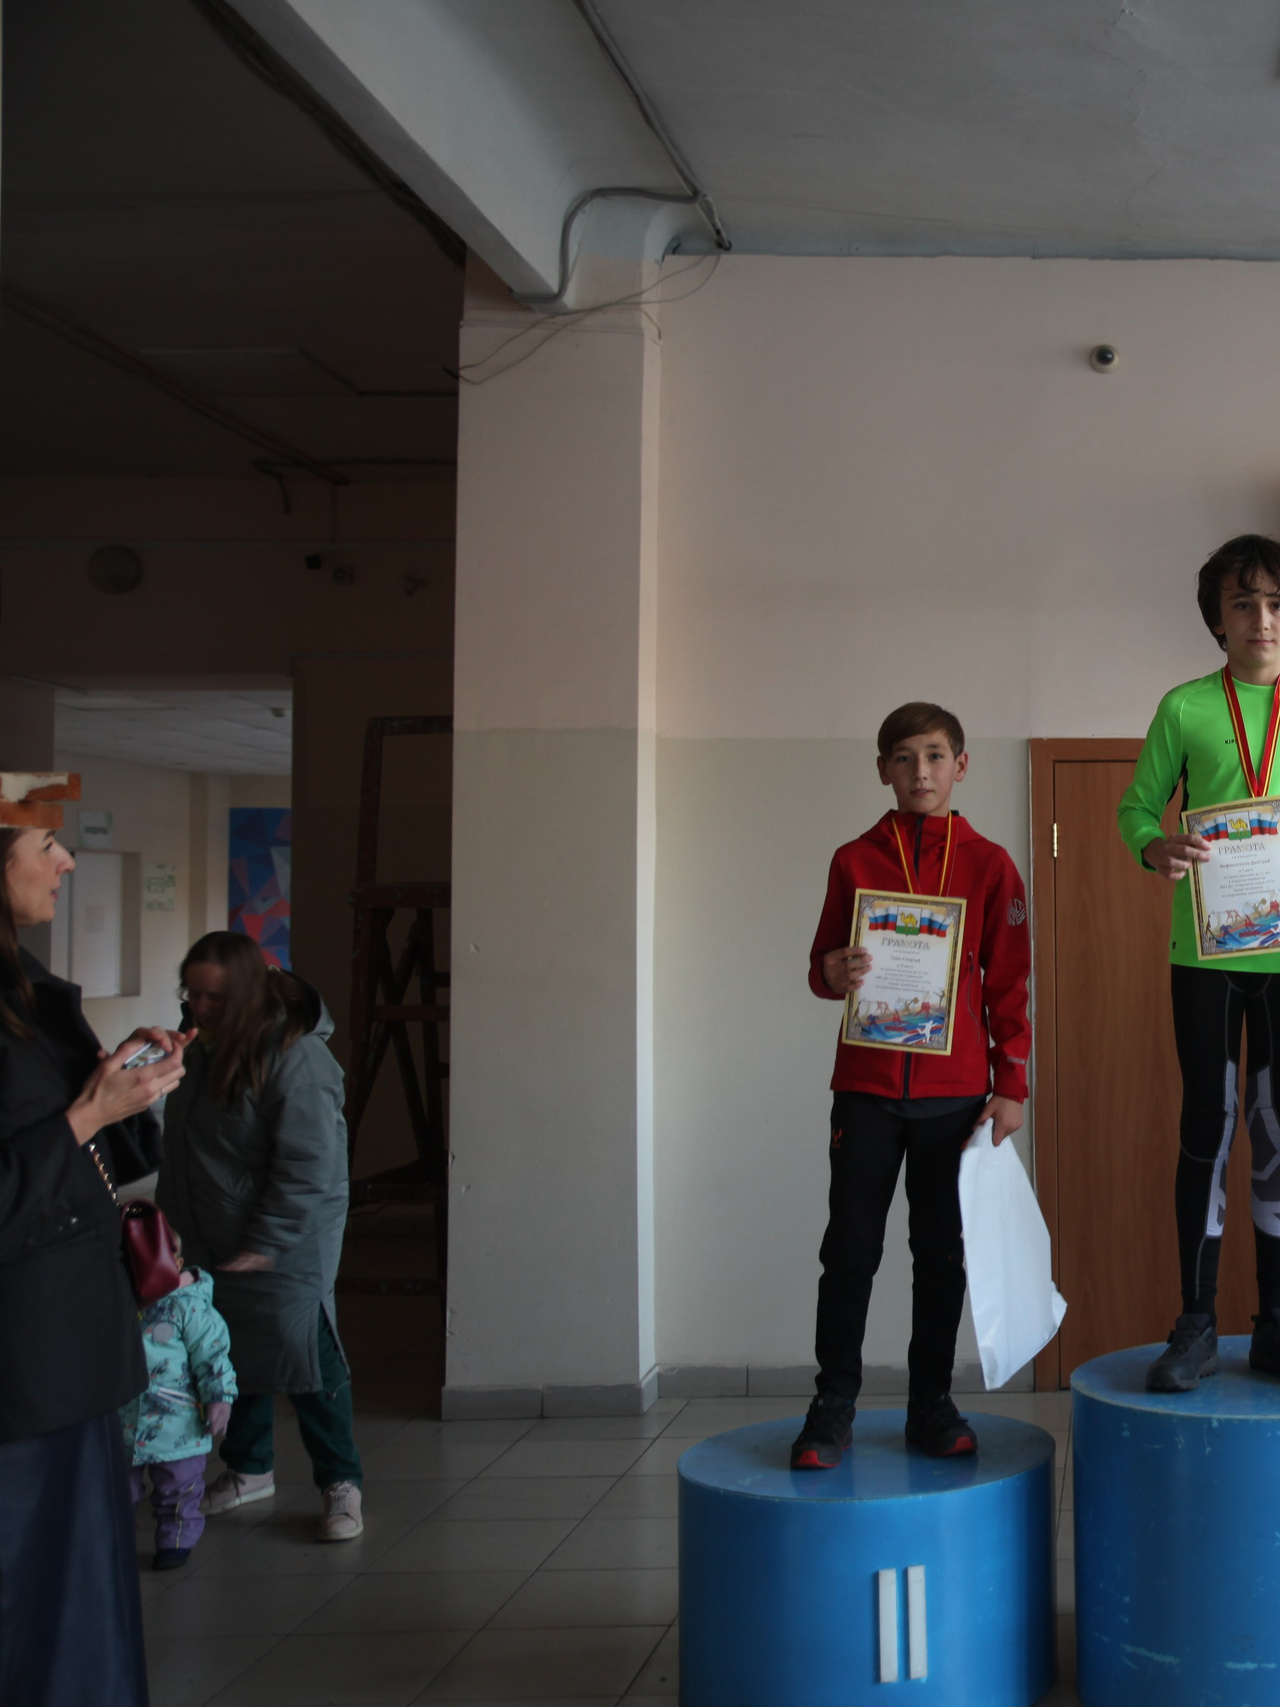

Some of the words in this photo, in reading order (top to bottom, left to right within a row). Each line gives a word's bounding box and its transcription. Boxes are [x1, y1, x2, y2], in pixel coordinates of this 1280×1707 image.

[1218, 842, 1266, 855] ГРАМОТА
[881, 937, 931, 950] ГРАМОТА
[877, 1565, 928, 1684] II
